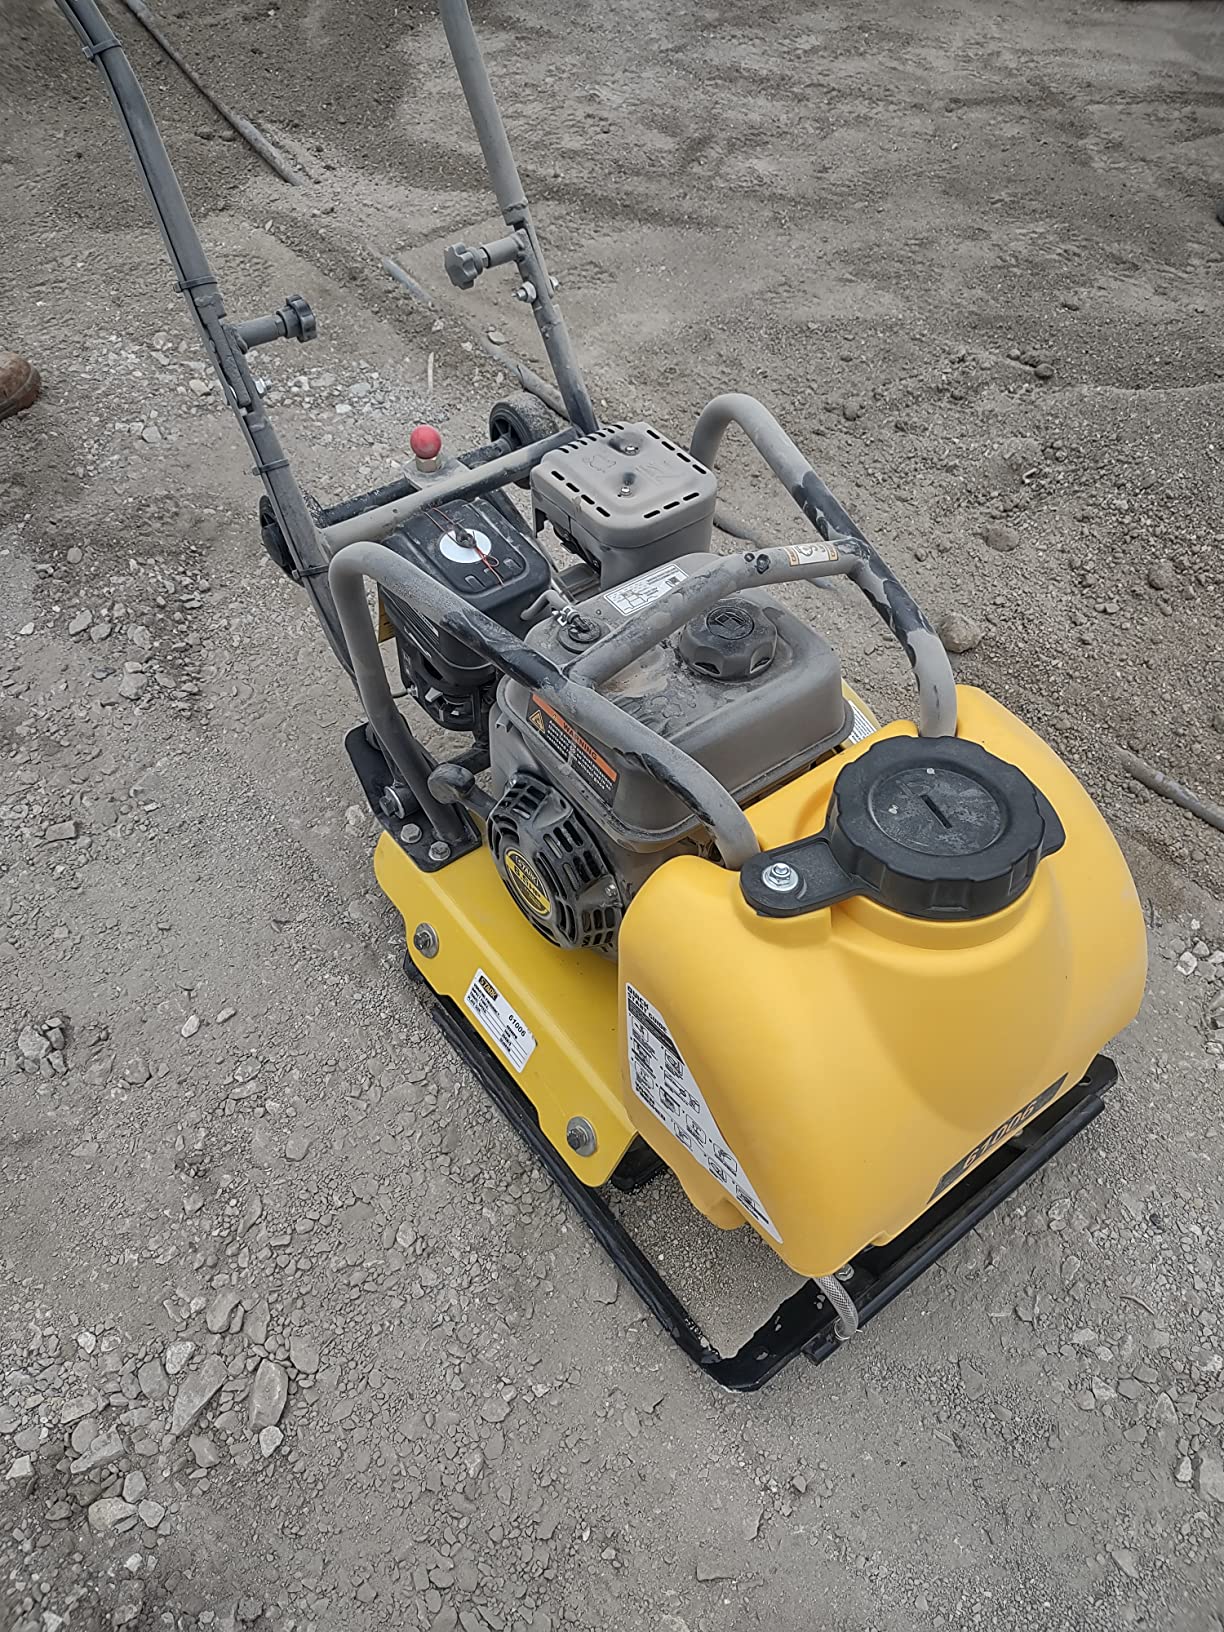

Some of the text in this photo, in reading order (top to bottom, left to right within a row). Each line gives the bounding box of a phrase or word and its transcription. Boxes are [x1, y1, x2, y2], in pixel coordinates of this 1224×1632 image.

[563, 722, 597, 760] WARNING
[480, 977, 498, 998] STARK
[508, 1014, 527, 1037] 61006
[963, 1101, 1037, 1169] 61006
